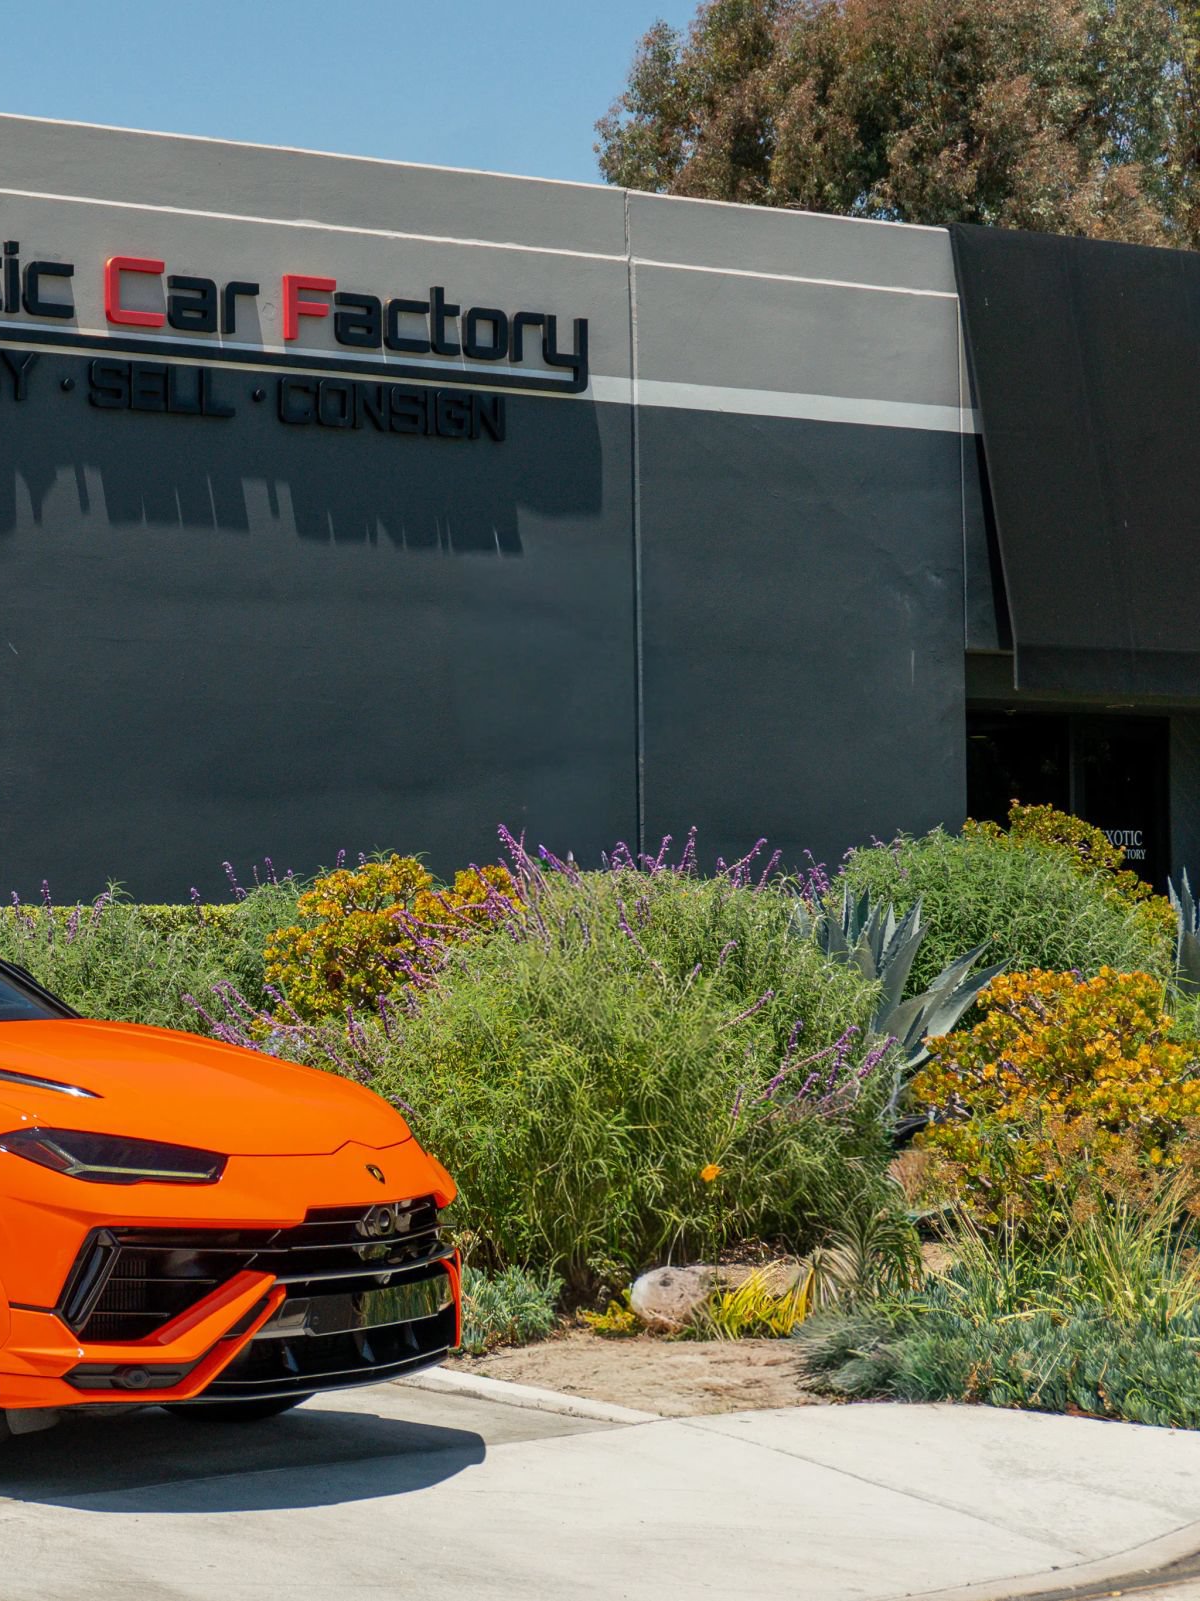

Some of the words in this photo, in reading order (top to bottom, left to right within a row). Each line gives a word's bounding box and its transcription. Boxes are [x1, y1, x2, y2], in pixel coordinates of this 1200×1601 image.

[104, 256, 260, 335] Car
[282, 273, 588, 394] Factory
[87, 357, 236, 419] SELL
[277, 375, 506, 443] CONSIGN
[1101, 829, 1143, 846] XOTIC
